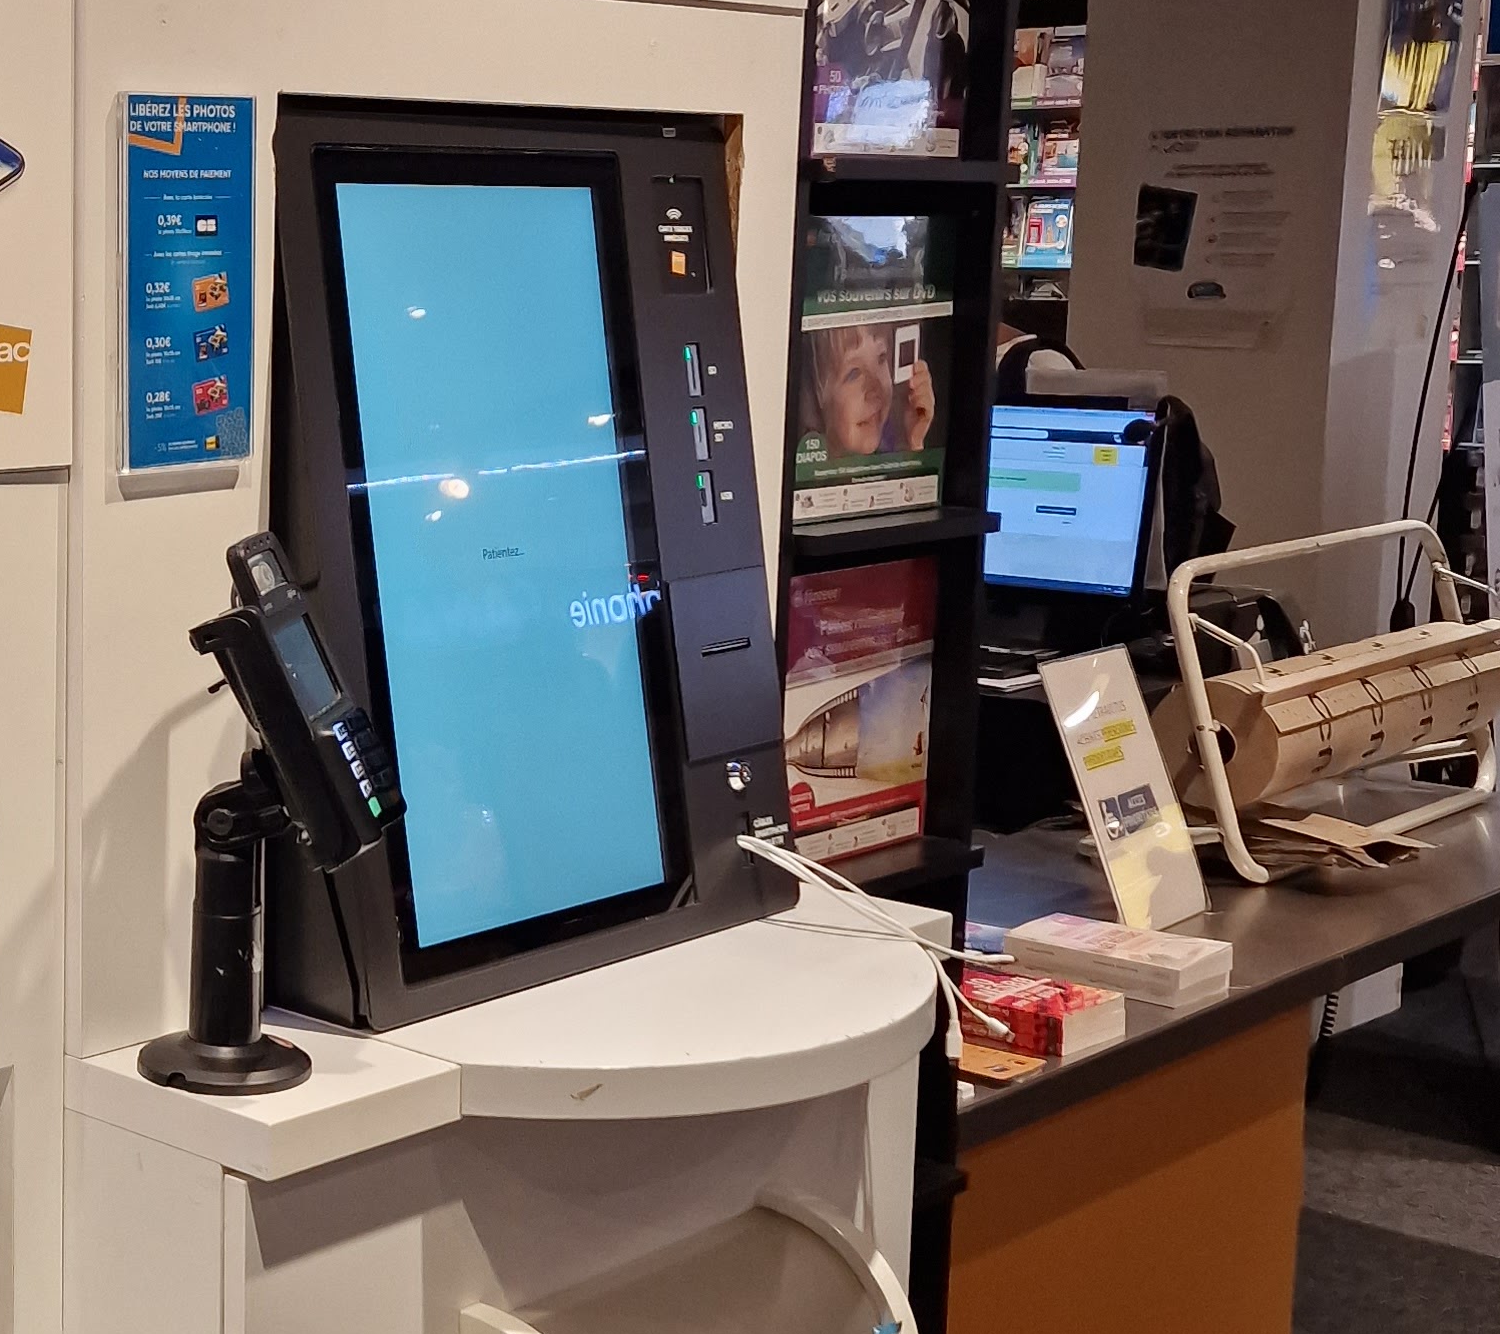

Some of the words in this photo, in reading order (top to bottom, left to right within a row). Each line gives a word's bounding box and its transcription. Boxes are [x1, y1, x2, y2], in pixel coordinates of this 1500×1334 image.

[129, 101, 171, 117] LIBÉREZ
[173, 105, 191, 117] LES
[193, 105, 236, 119] PHOTOS
[129, 121, 142, 132] DE
[143, 121, 172, 132] VOTRE
[173, 122, 231, 134] SMARTPHONE
[143, 170, 158, 179] NOS
[157, 215, 182, 227] 0,39€
[145, 282, 171, 295] 0,32€
[145, 336, 172, 349] 0,30€
[804, 438, 821, 450] 150
[795, 450, 828, 464] DIAPOS
